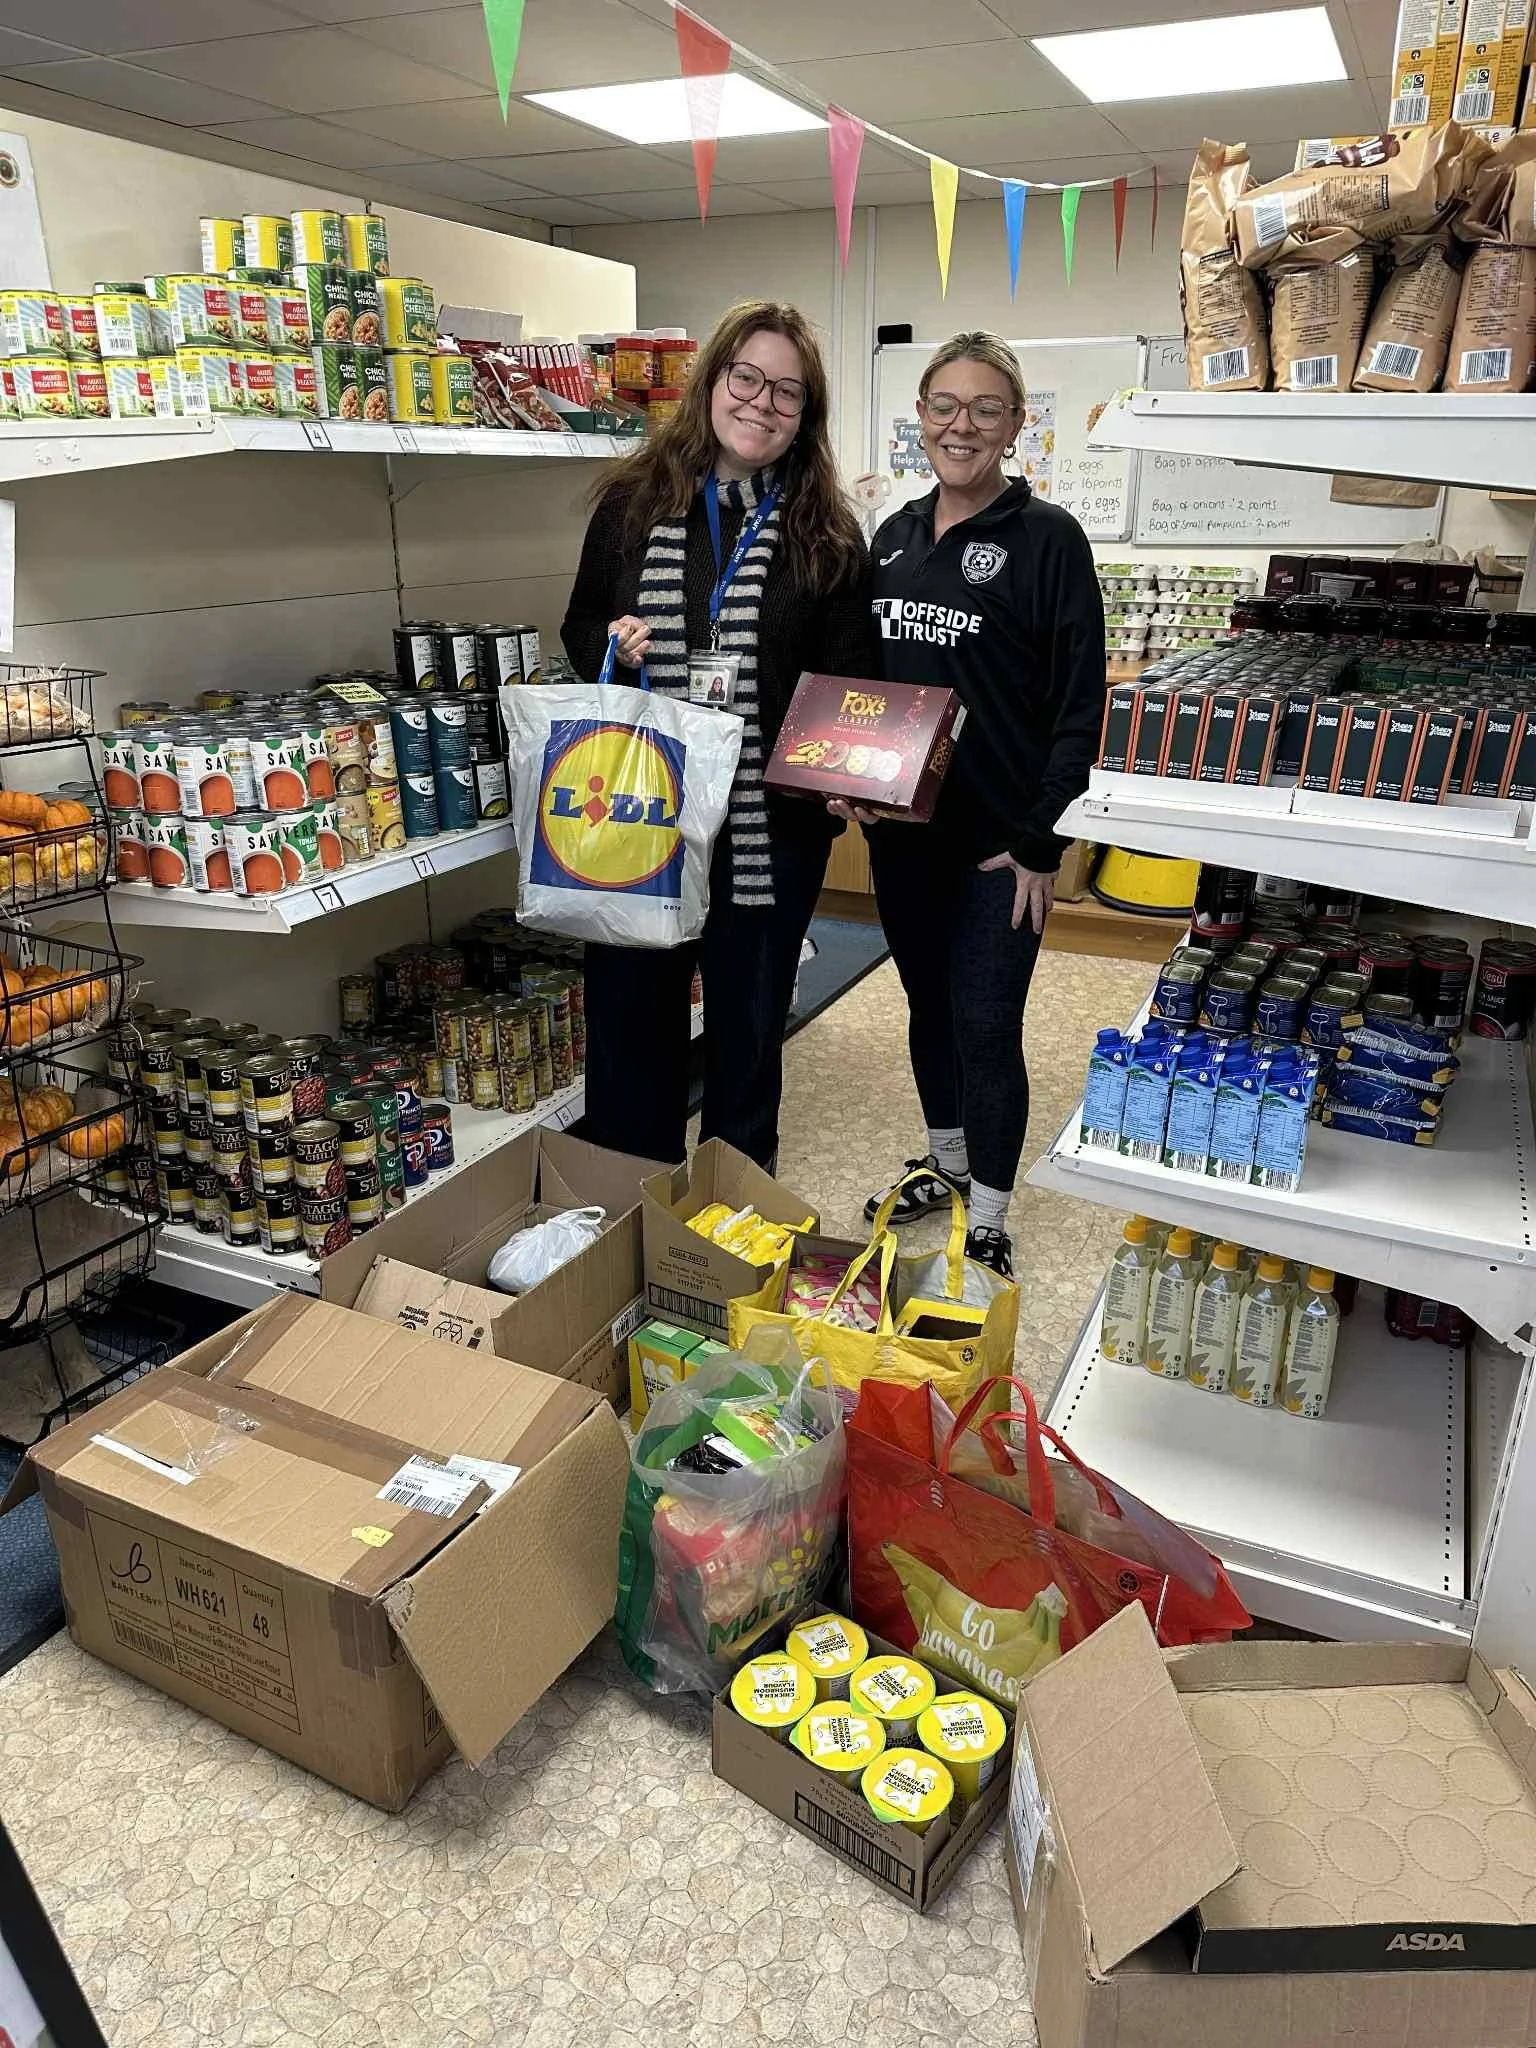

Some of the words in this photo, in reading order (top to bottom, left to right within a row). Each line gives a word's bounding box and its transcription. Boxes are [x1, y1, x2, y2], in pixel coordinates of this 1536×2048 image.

[894, 454, 915, 465] Help
[1058, 459, 1073, 474] 12
[1079, 461, 1104, 474] eggs
[1154, 455, 1175, 473] Bag
[1058, 480, 1074, 494] for
[1081, 498, 1090, 511] 6
[1095, 497, 1121, 512] eggs
[1152, 499, 1172, 514] Bag
[1193, 500, 1225, 510] onions
[1150, 519, 1169, 533] Bag
[903, 600, 983, 634] OFFSIDE
[902, 620, 961, 647] TRUST
[837, 715, 881, 727] CLASSIC
[419, 860, 428, 873] 7
[321, 891, 333, 905] 7
[1358, 960, 1370, 974] esu
[296, 1138, 340, 1157] STAGG
[305, 1151, 334, 1162] CHILI
[242, 1584, 274, 1608] Quantity
[252, 1612, 270, 1640] 48
[961, 1600, 995, 1651] GO
[921, 1613, 1020, 1704] bananas
[1385, 1932, 1465, 1952] ASDA
